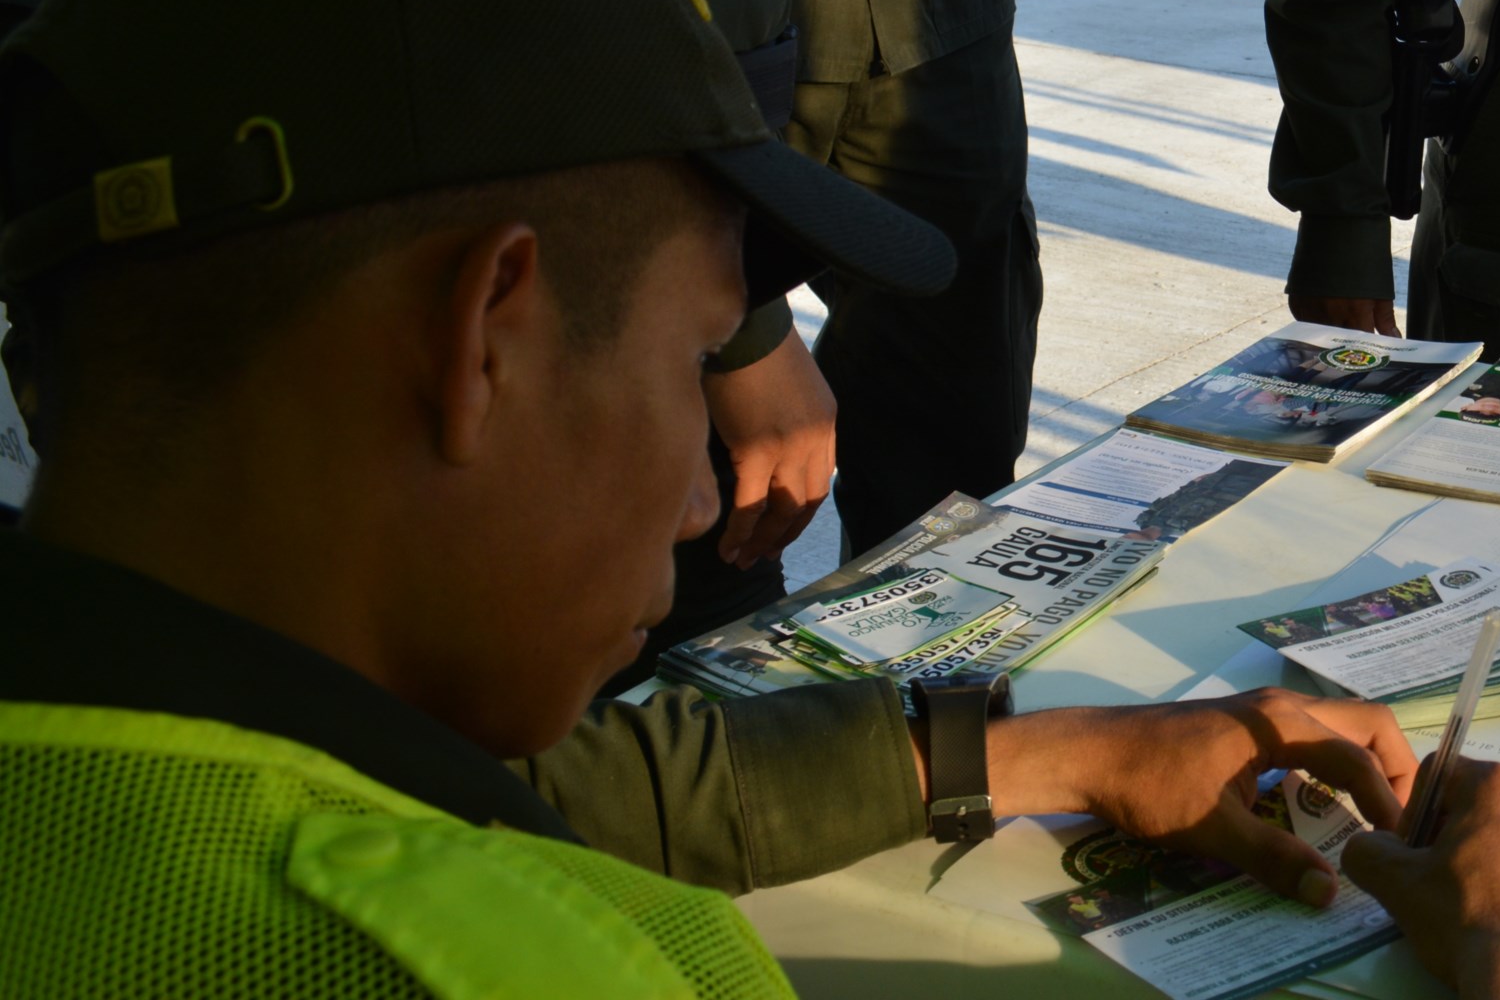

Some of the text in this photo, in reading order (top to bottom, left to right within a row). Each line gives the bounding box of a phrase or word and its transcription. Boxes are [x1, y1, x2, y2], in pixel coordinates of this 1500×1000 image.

[965, 526, 1048, 570] GAULA
[996, 534, 1108, 587] 165
[1083, 567, 1128, 589] NO
[847, 606, 907, 630] GAULA
[1032, 589, 1099, 626] PAGO
[847, 610, 916, 638] DENUNCIO
[997, 632, 1042, 651] YO
[1477, 739, 1495, 752] al
[1316, 816, 1362, 854] NACIONAL
[1113, 893, 1218, 938] DEFINA SU SITUACIÓN
